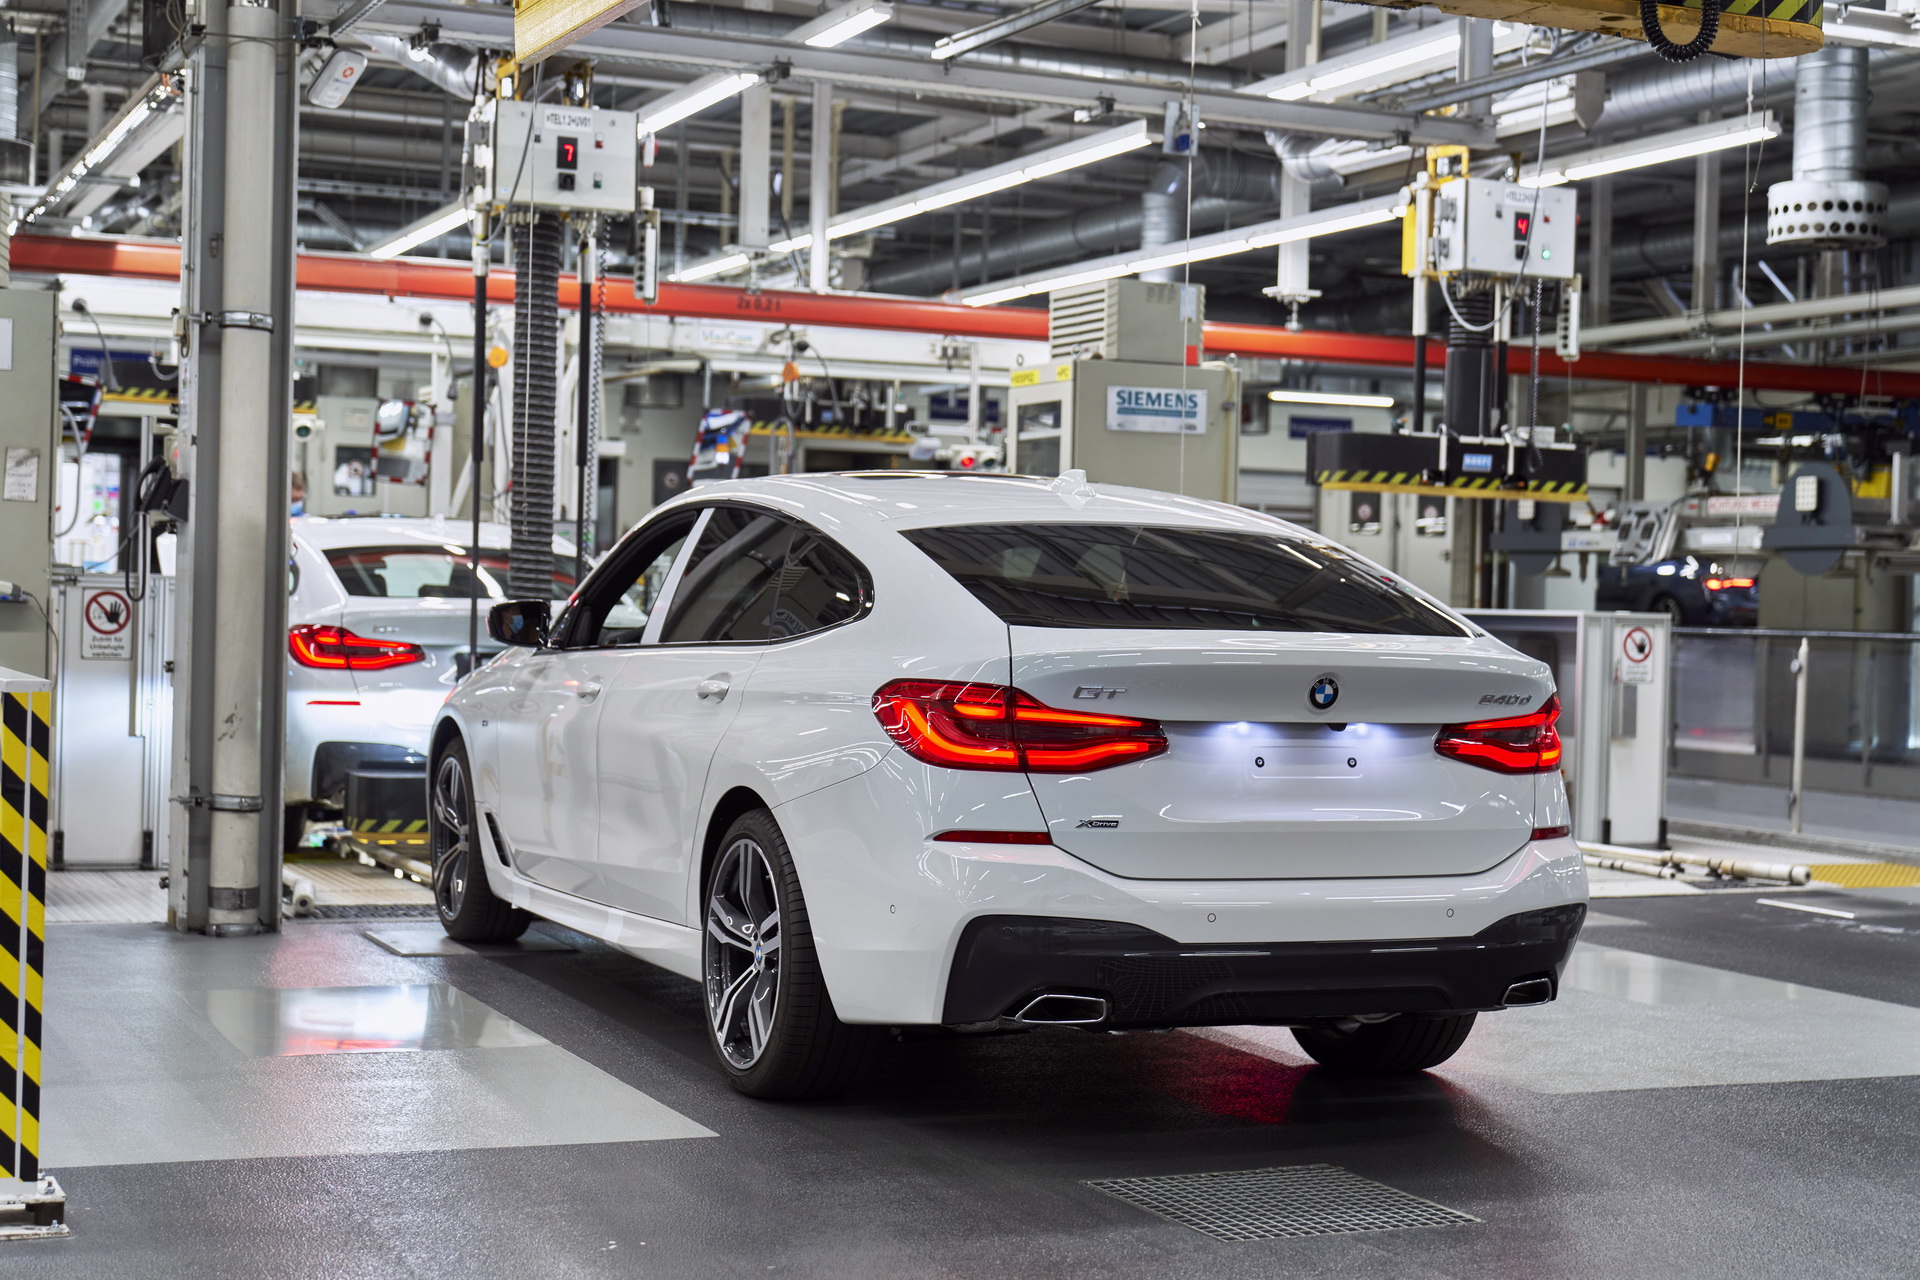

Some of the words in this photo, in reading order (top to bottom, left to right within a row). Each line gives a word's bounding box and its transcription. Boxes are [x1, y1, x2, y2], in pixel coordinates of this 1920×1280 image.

[563, 143, 575, 162] 7
[1517, 218, 1529, 235] 4
[1116, 390, 1198, 409] SIEMENS
[1073, 685, 1128, 700] GT
